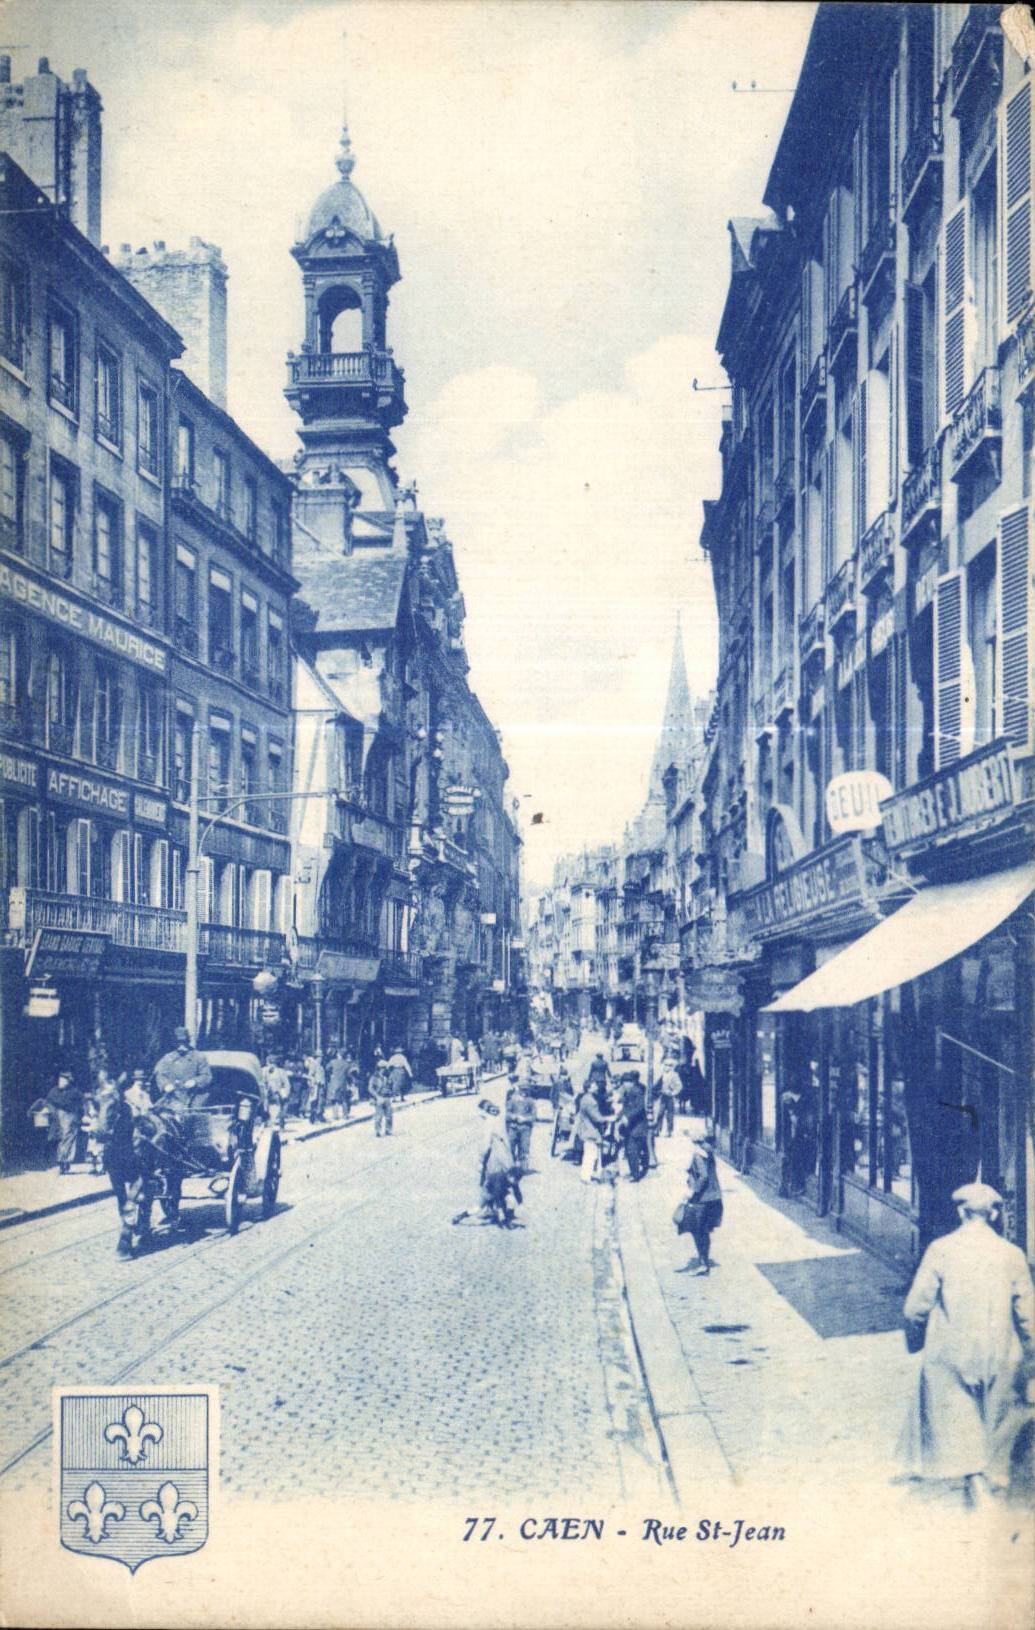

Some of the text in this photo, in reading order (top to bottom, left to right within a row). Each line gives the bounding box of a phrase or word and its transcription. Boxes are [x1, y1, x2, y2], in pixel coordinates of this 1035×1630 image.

[0, 564, 166, 671] AGENCE MAURICE
[48, 769, 129, 813] AFFICHAGE
[830, 782, 880, 820] EUI
